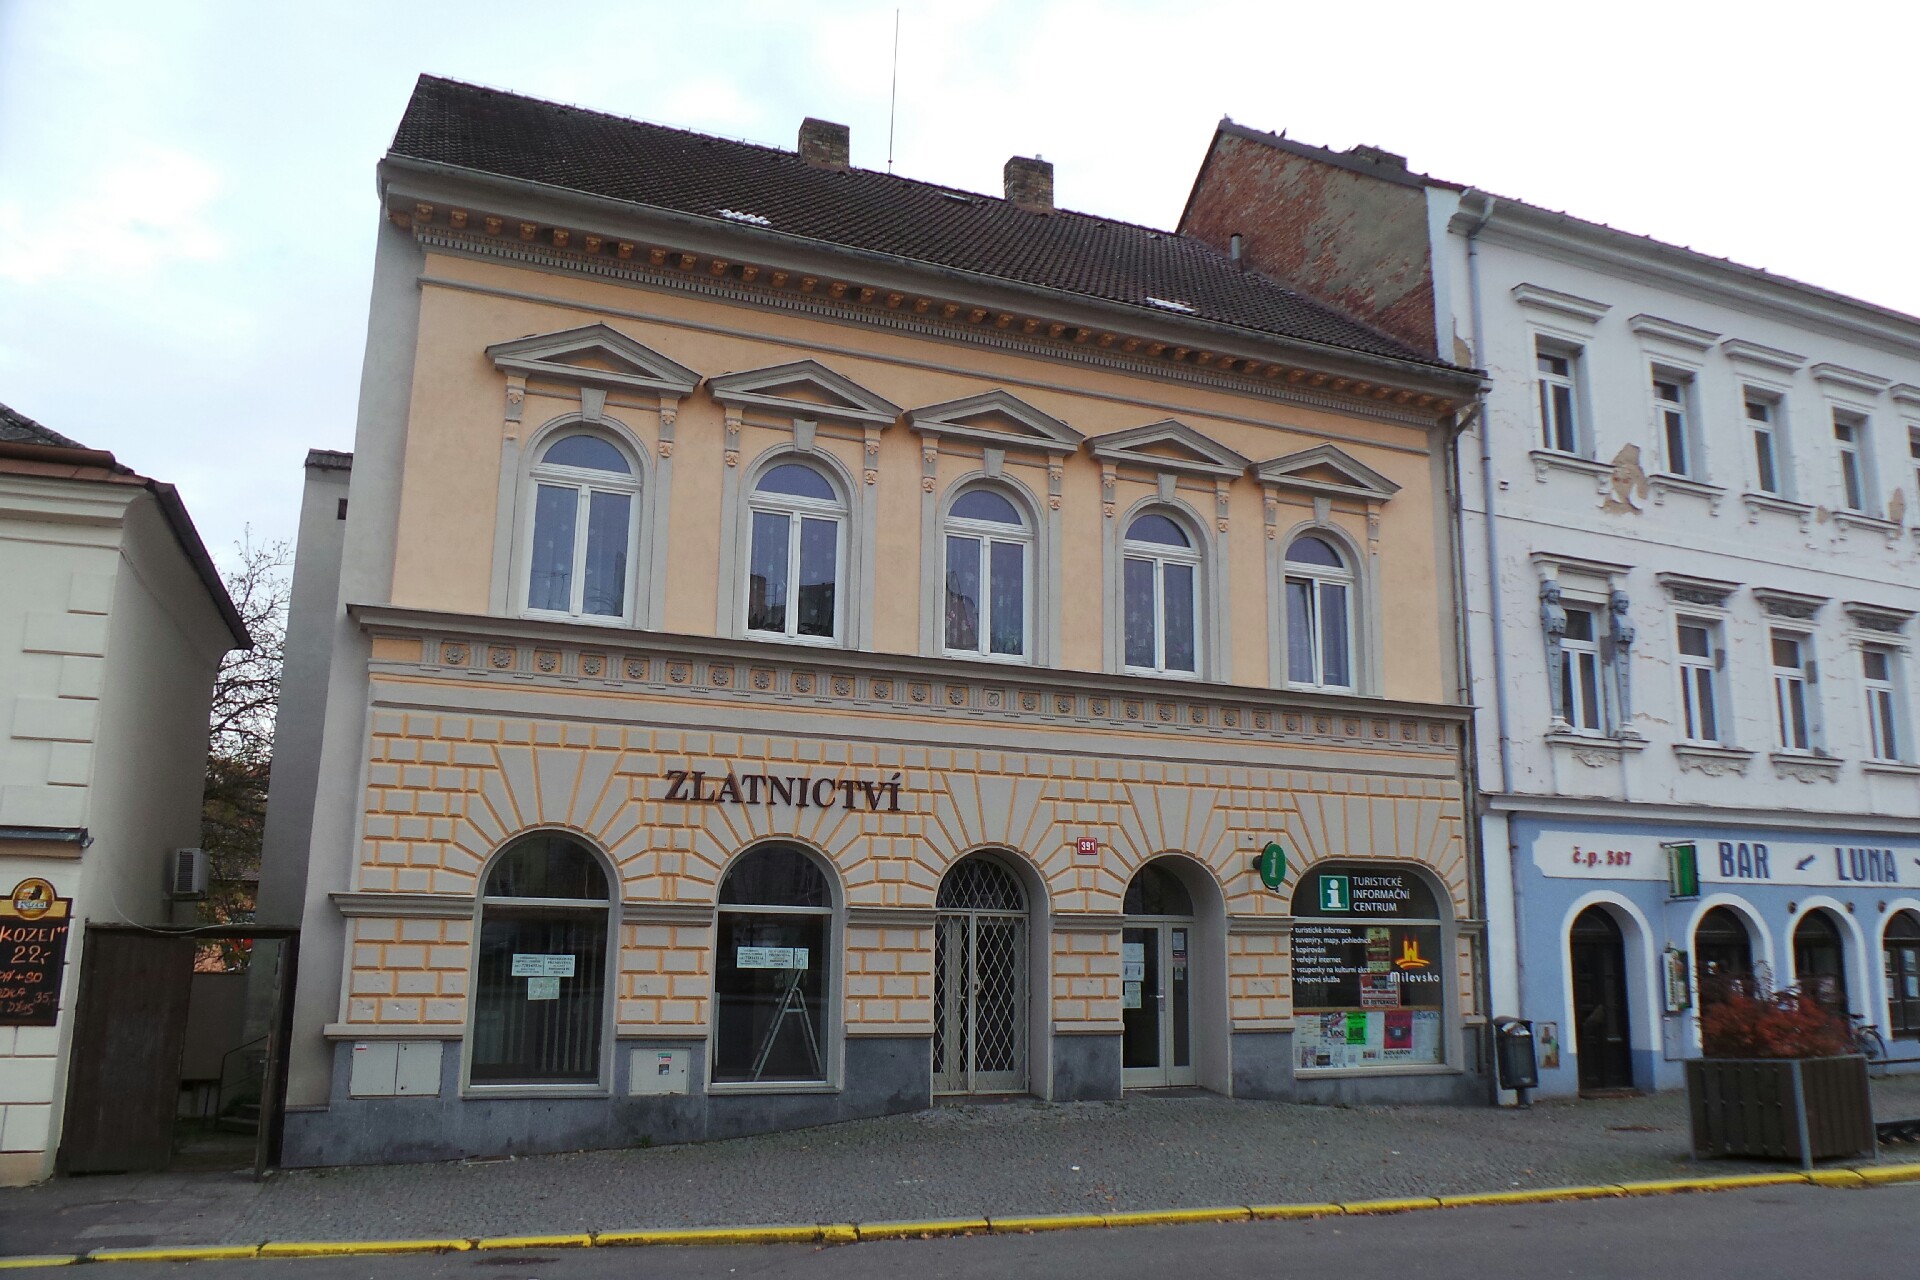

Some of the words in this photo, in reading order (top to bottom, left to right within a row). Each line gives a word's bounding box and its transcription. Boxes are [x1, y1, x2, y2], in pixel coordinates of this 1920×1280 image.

[664, 769, 902, 811] ZLATNICTVÍ
[1081, 841, 1095, 851] 391
[1718, 841, 1769, 878] BAR
[1834, 847, 1898, 882] LUNA
[1352, 875, 1403, 887] TURISTICKÉ
[1353, 888, 1410, 899] INFORMAČNÍ
[1353, 902, 1398, 912] CENTRUM
[1390, 971, 1440, 983] Milevsko
